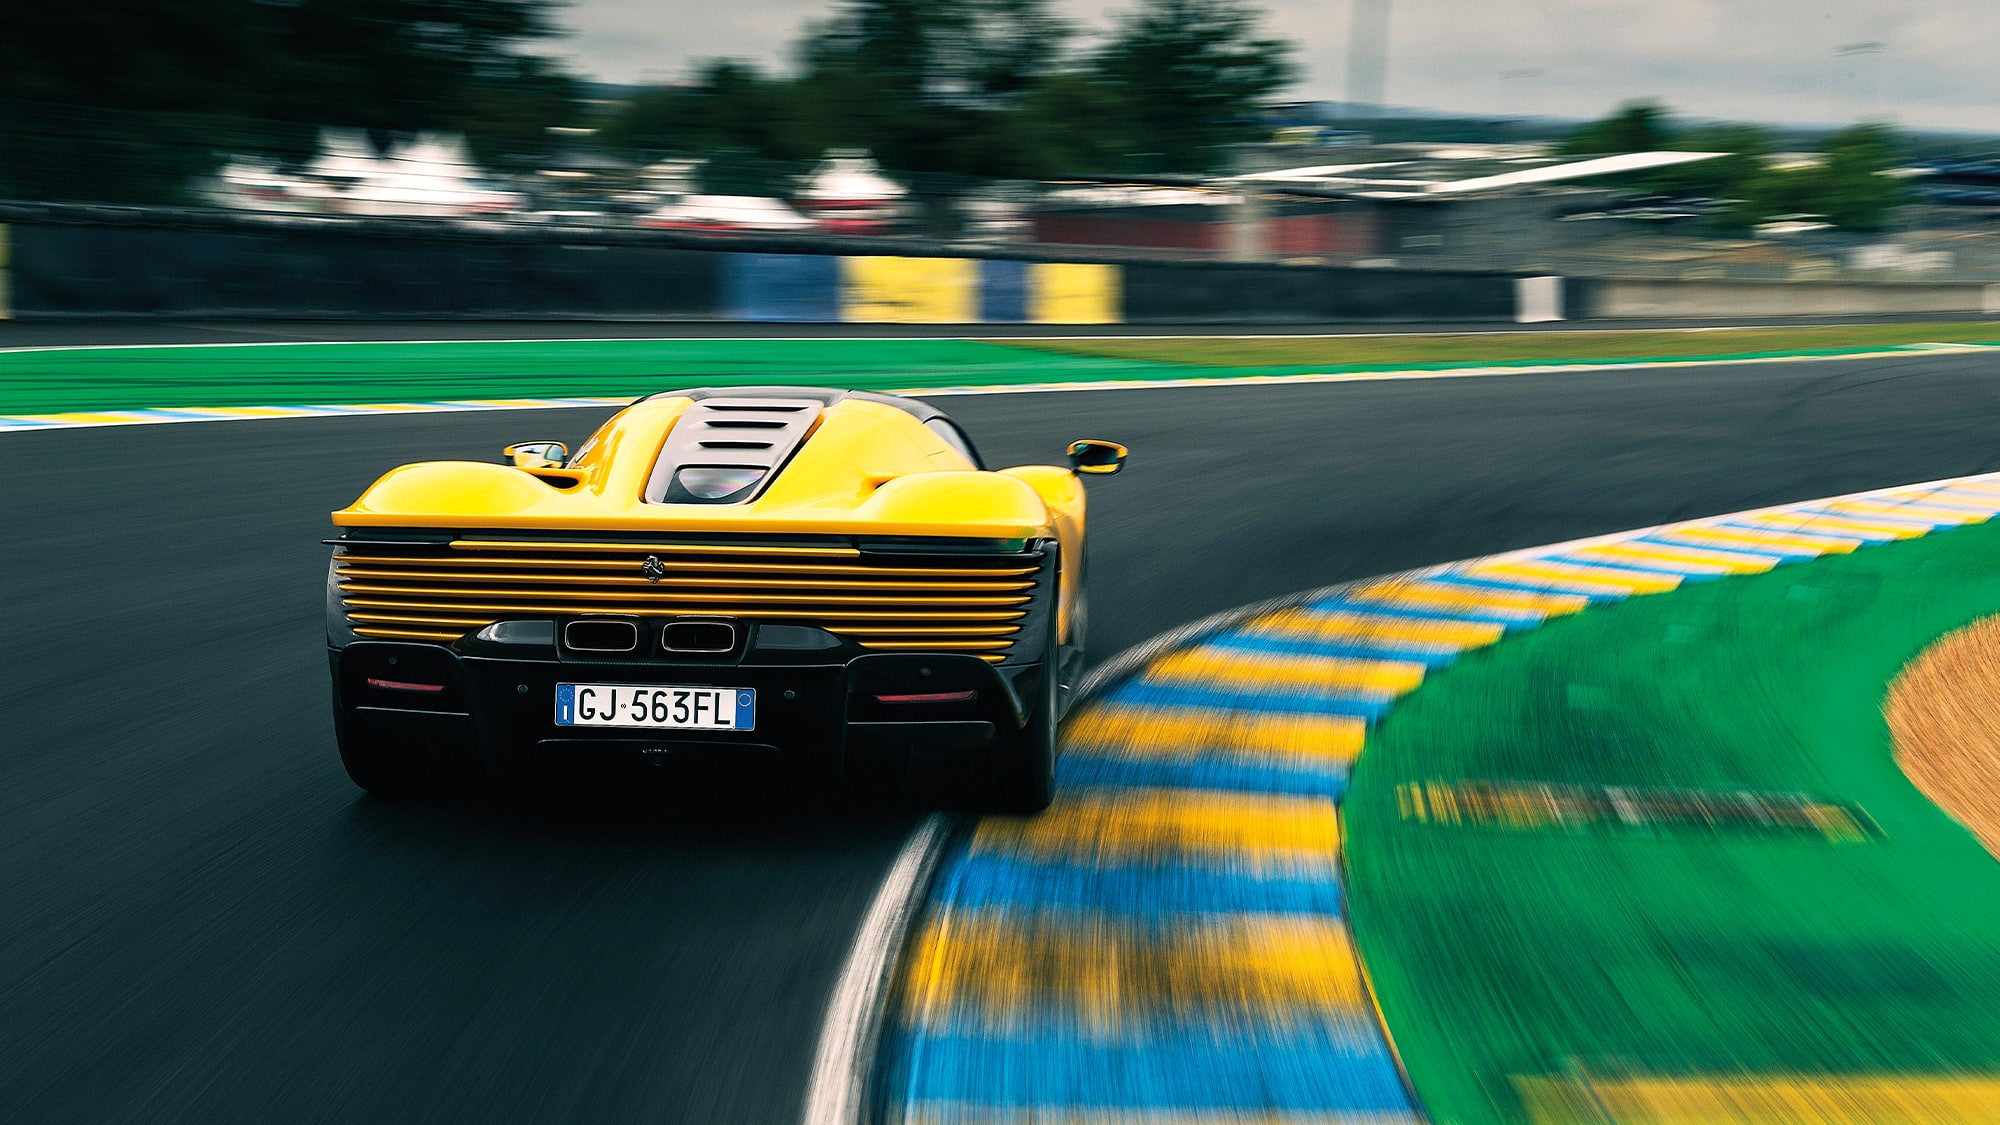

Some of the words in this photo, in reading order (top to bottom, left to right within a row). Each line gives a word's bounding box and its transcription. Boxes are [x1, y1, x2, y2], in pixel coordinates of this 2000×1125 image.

[563, 705, 568, 721] I
[578, 688, 617, 721] GJ
[631, 690, 731, 725] 563FL
